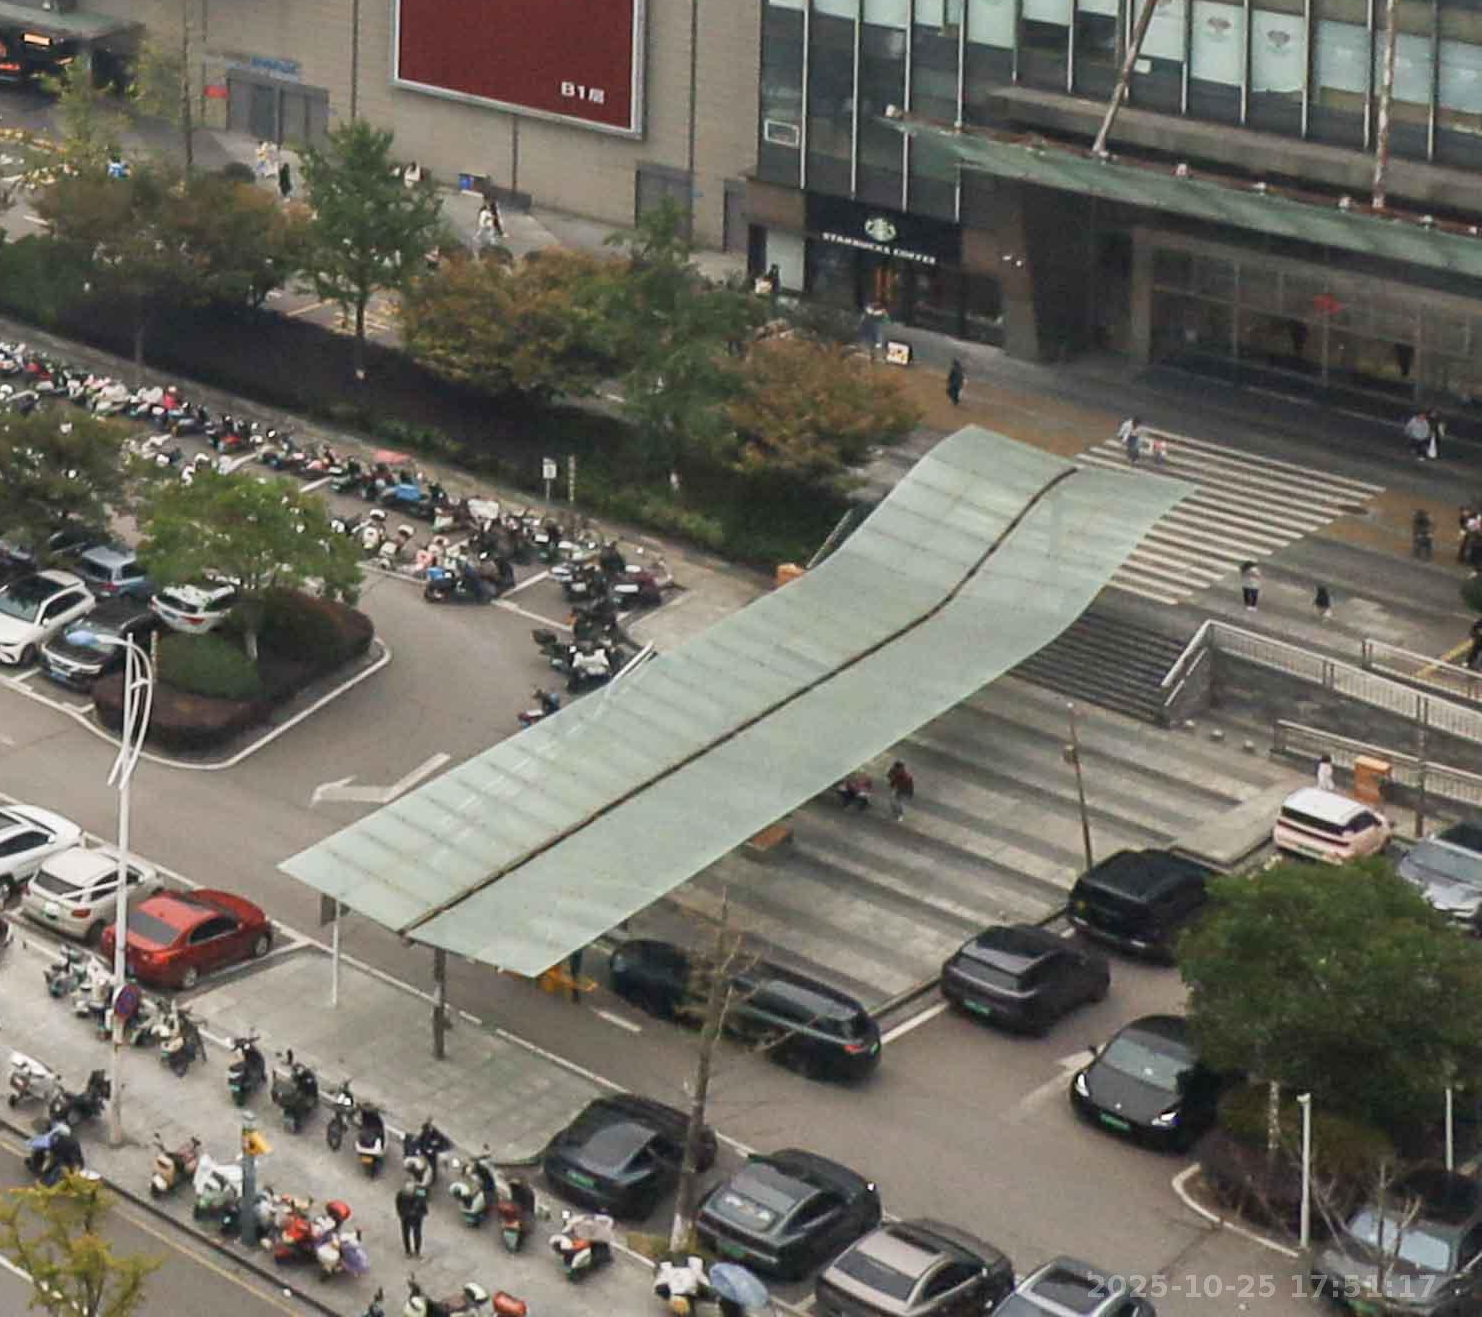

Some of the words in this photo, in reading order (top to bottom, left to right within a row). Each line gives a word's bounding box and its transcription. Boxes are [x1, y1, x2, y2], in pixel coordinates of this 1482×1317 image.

[560, 80, 605, 105] B1层
[822, 230, 891, 256] STARBUCKS
[893, 247, 937, 266] COFFEE
